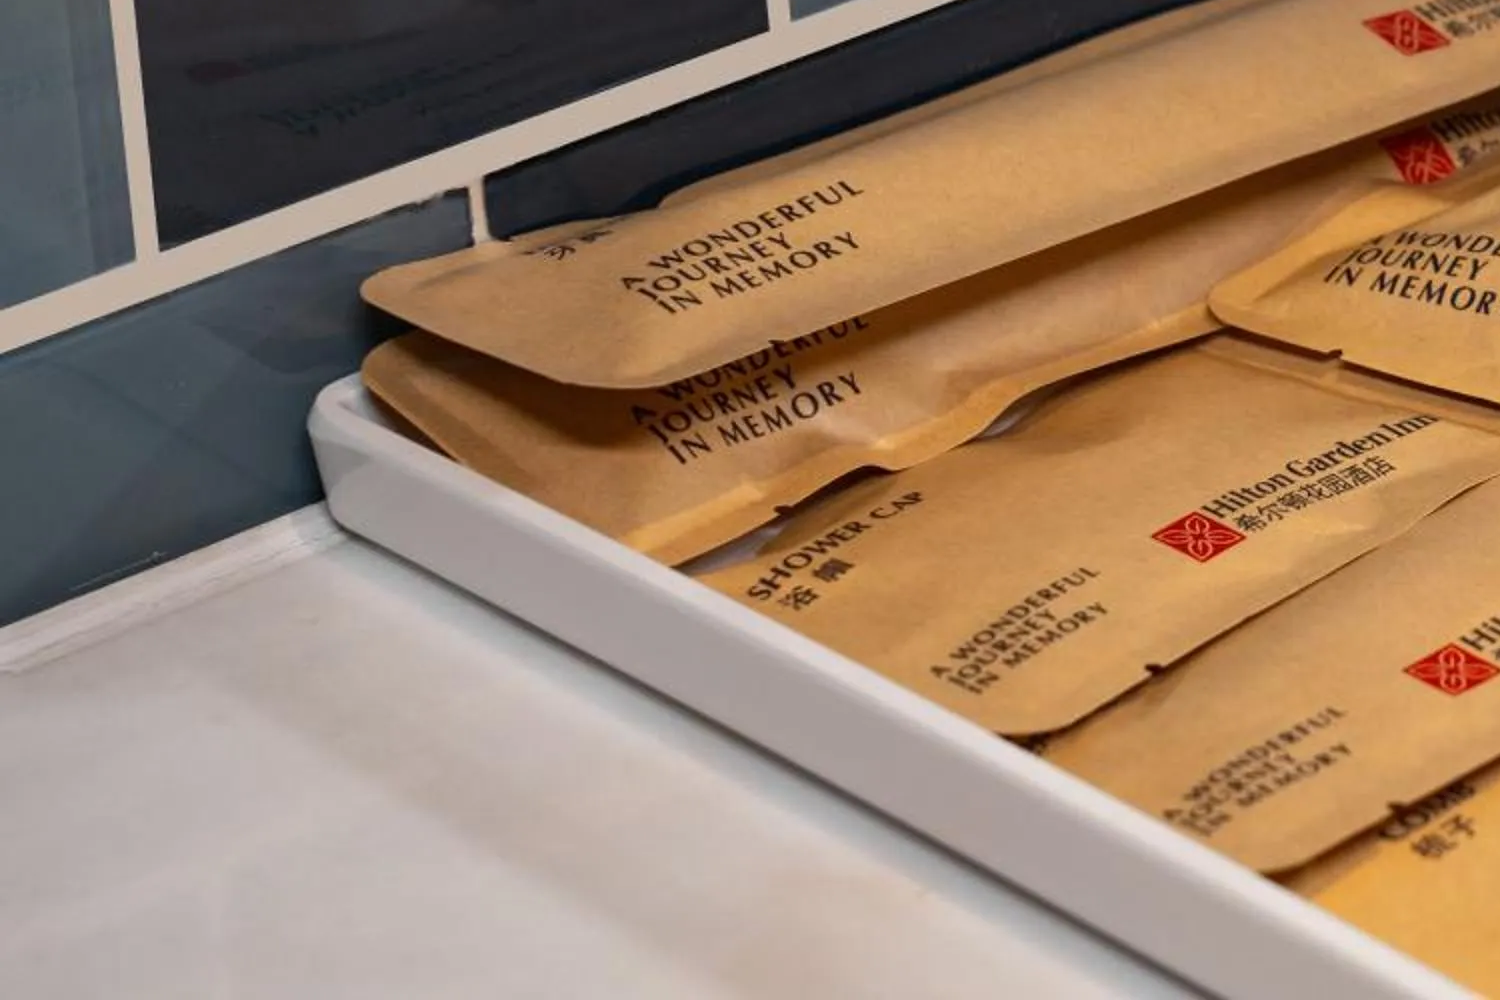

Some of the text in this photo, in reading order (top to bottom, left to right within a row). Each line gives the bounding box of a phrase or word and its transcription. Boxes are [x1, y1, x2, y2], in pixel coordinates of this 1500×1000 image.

[621, 276, 645, 290] A
[648, 180, 865, 270] WONDERFUL
[638, 232, 792, 300] JOURNEY
[657, 231, 860, 314] IN MEMORY
[1323, 265, 1363, 286] IN
[1342, 247, 1489, 281] JOURNEY
[631, 405, 657, 425] A
[648, 364, 797, 444] JOURNEY
[667, 372, 863, 465] IN MEMORY
[1201, 413, 1441, 519] Hilton Garden Inn
[1232, 455, 1397, 532] 希尔顿花园酒店
[747, 491, 924, 601] SHOWER CAP
[930, 567, 1101, 679] A WONDERFUL
[947, 609, 1057, 688] JOURNEY
[967, 601, 1109, 695] IN MEMORY
